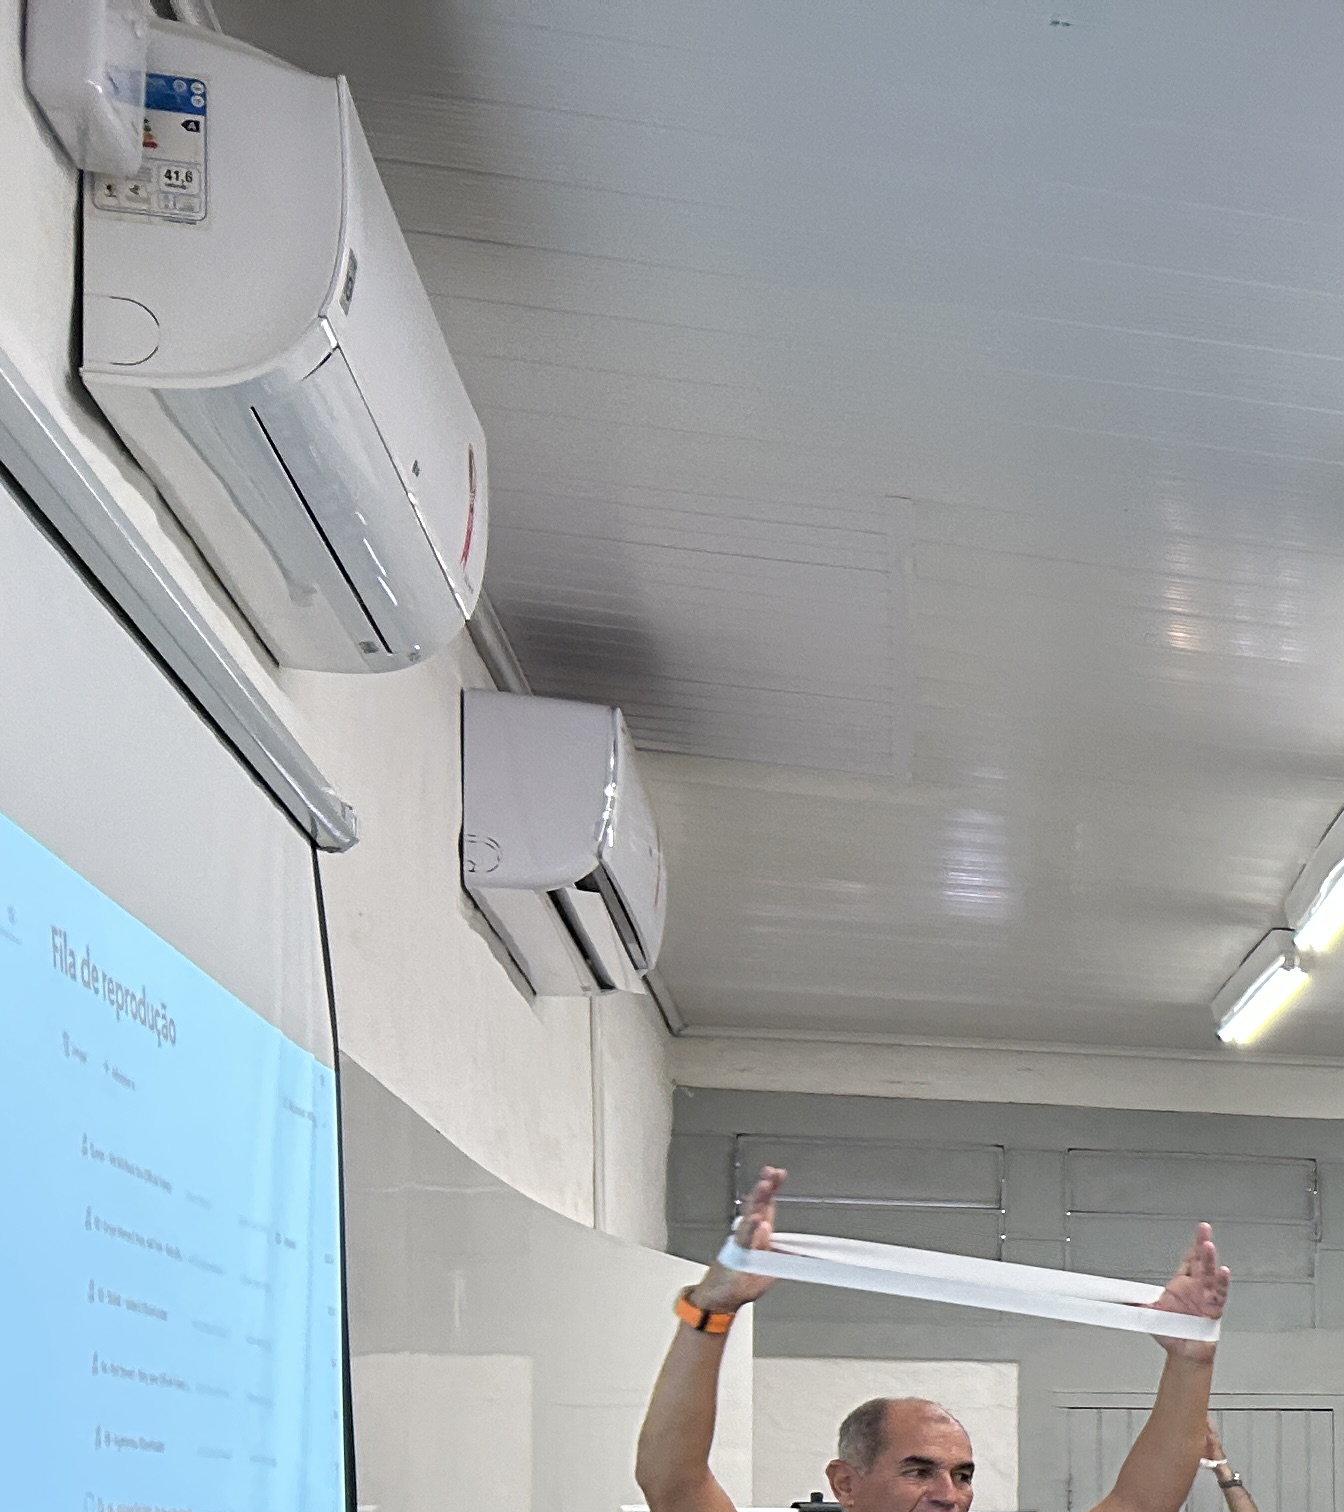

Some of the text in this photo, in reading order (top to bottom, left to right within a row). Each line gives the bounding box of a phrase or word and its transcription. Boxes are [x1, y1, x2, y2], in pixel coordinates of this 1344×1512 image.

[51, 924, 176, 1048] Fila de reprodução
